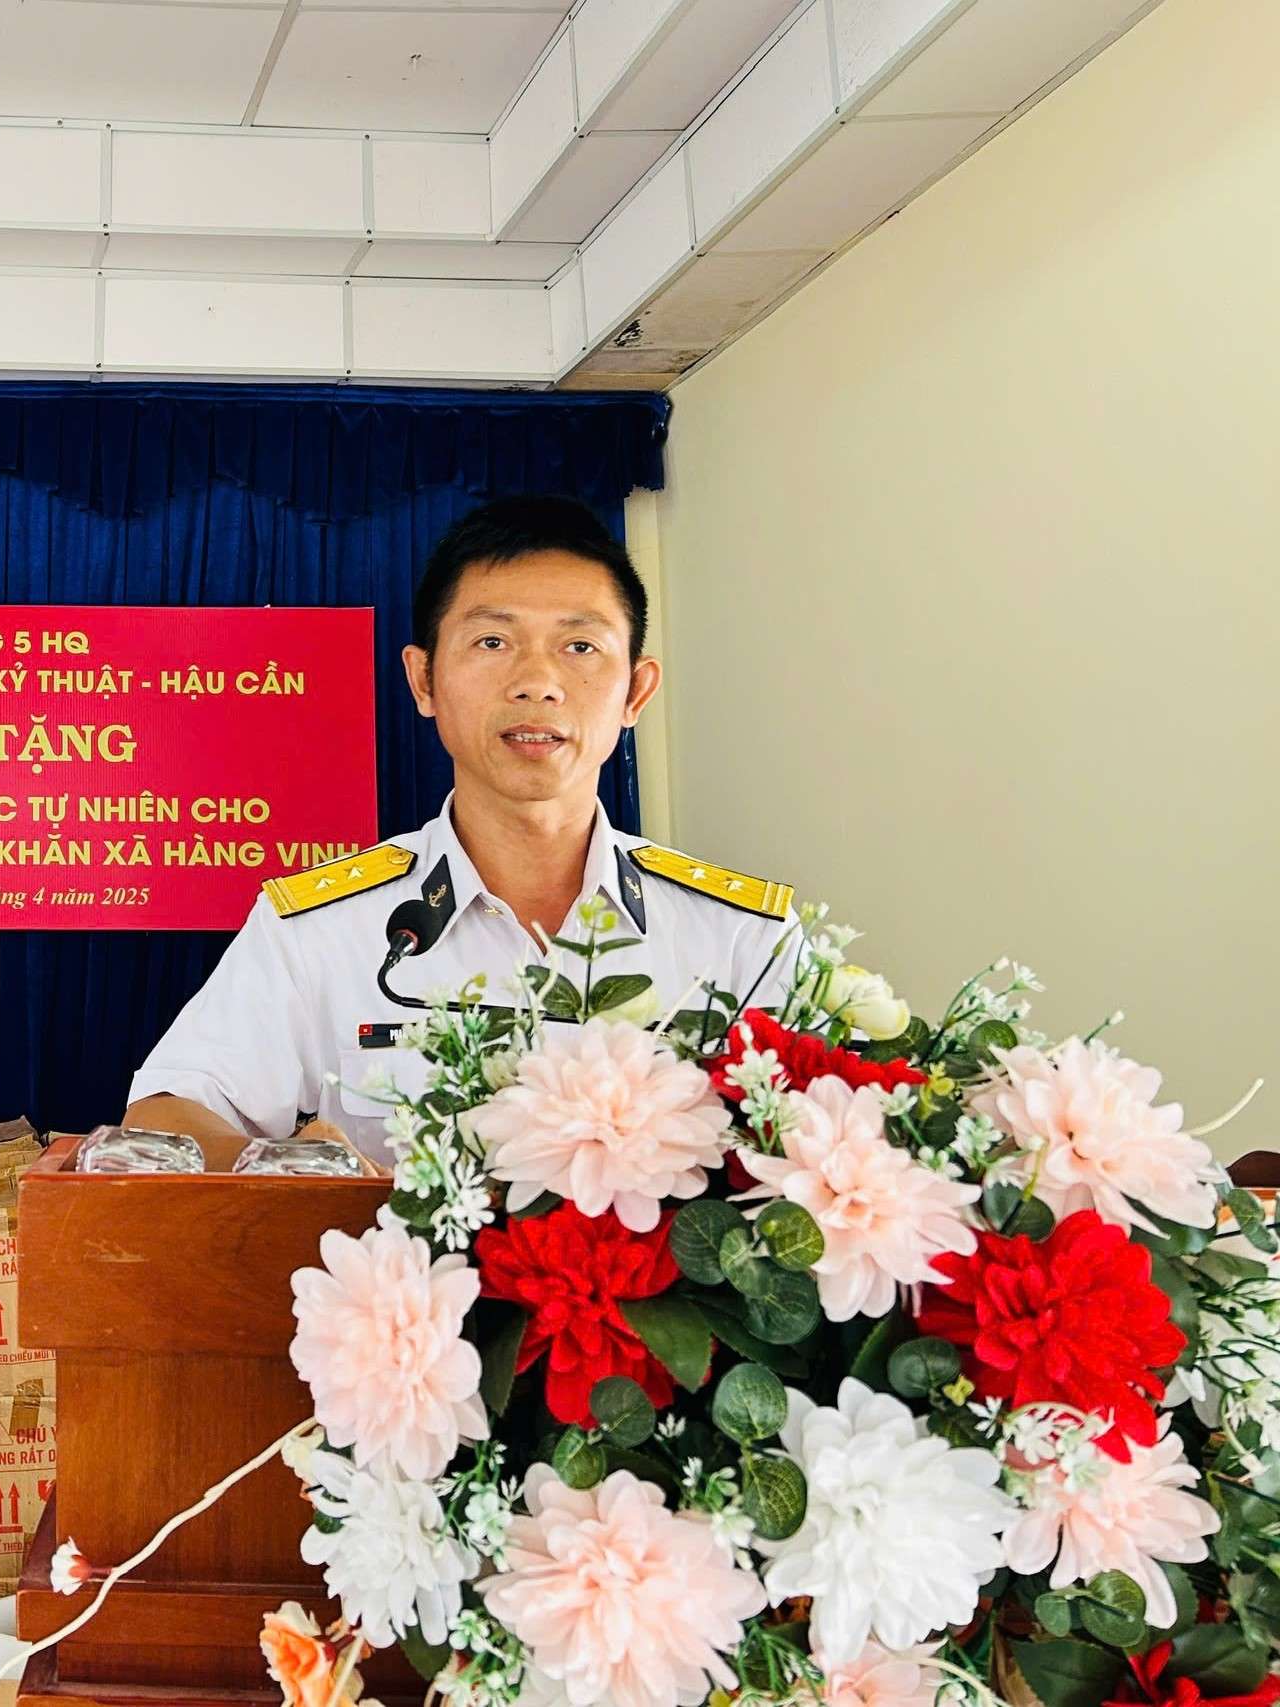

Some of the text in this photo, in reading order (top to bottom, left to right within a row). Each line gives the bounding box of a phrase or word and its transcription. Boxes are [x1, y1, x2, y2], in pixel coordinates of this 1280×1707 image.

[14, 631, 32, 653] 5
[42, 631, 90, 655] HQ
[37, 664, 133, 700] THUẬT
[161, 664, 225, 700] HẬU
[235, 660, 305, 695] CẦN
[28, 794, 68, 829] TỰ
[79, 790, 179, 823] NHIÊN
[191, 798, 270, 823] CHO
[103, 834, 153, 867] XÃ
[164, 834, 265, 867] HÀNG
[276, 842, 359, 867] VINH
[32, 887, 45, 905] 4
[51, 888, 95, 905] năm
[101, 887, 150, 905] 2025
[2, 1258, 18, 1277] RẤ
[16, 1424, 46, 1444] CHÚ
